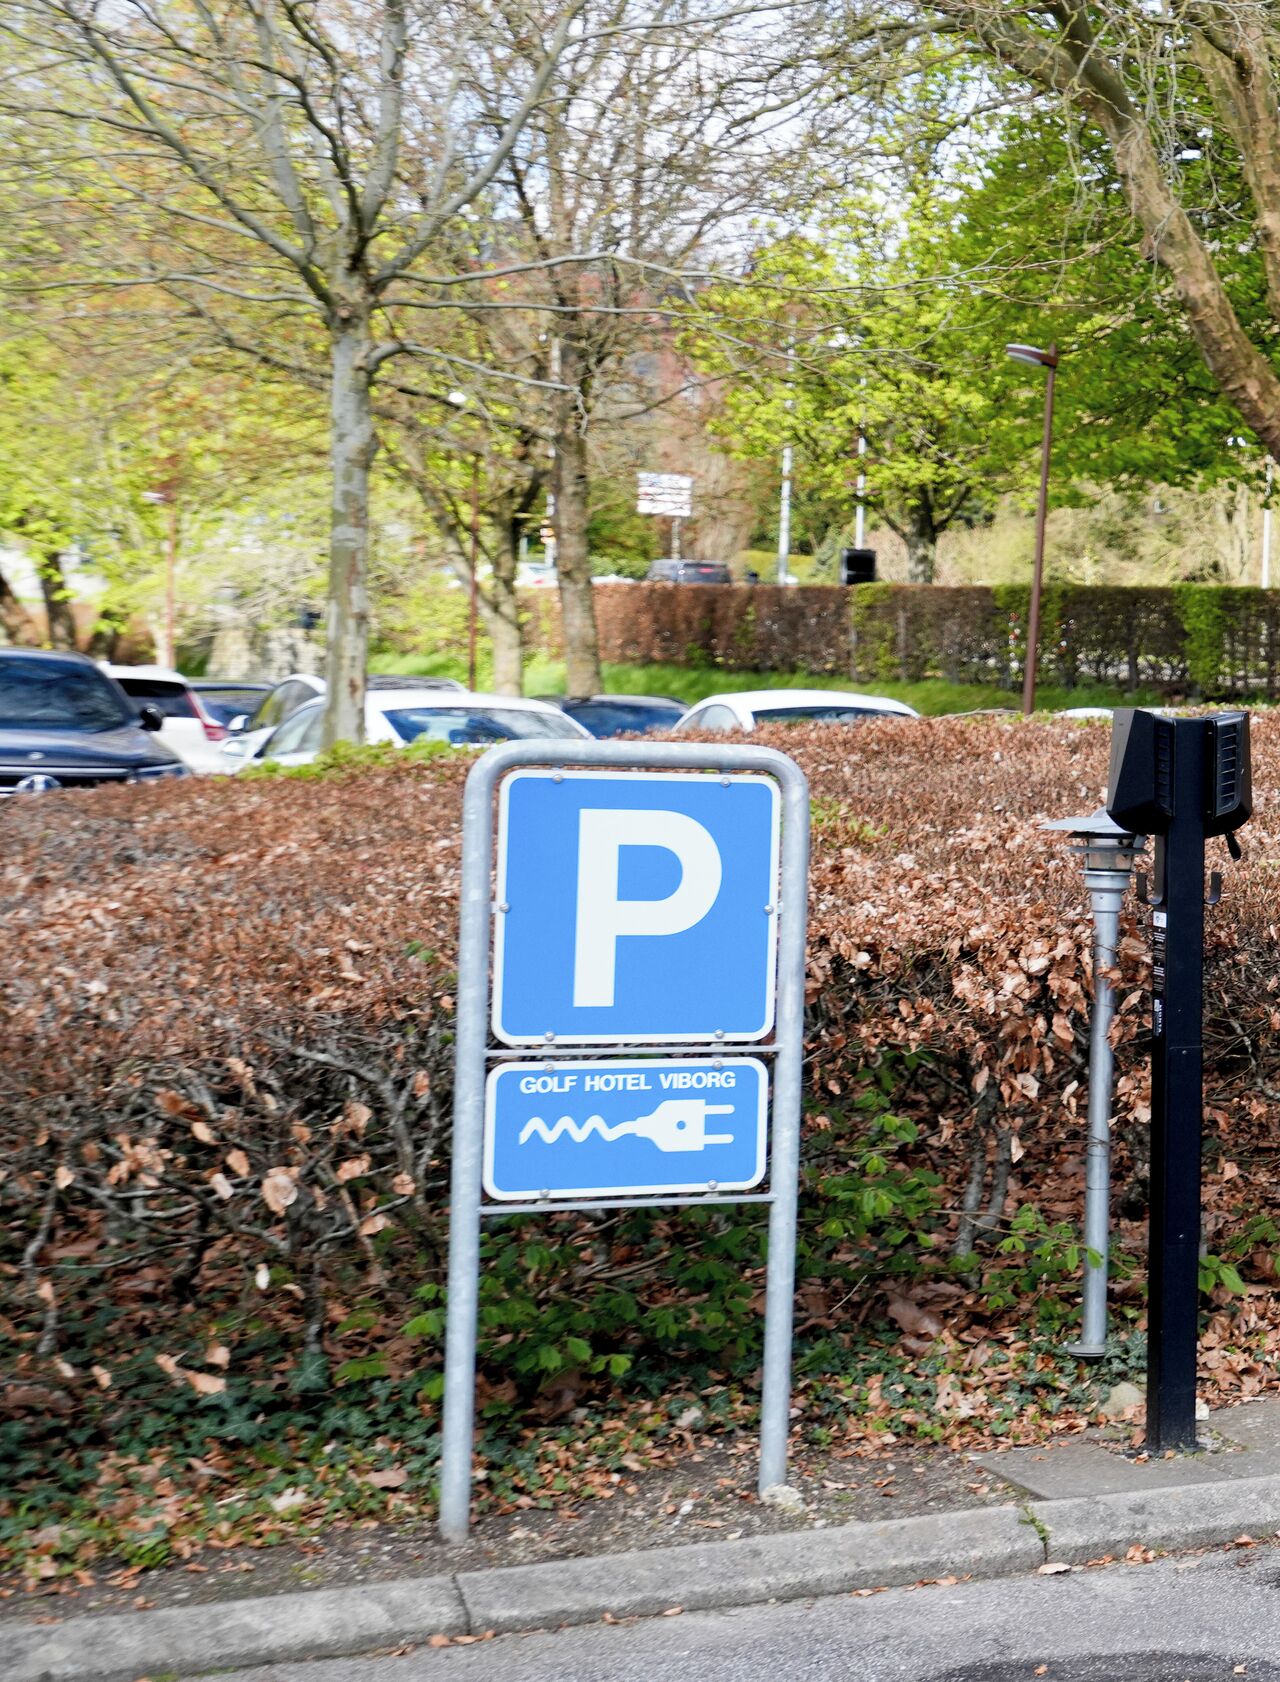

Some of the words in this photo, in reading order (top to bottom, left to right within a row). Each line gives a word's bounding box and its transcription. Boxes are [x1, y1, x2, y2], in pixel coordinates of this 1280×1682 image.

[572, 808, 722, 1008] P
[519, 1075, 577, 1094] GOLF
[584, 1073, 652, 1092] HOTEL
[659, 1071, 736, 1090] VIBORG
